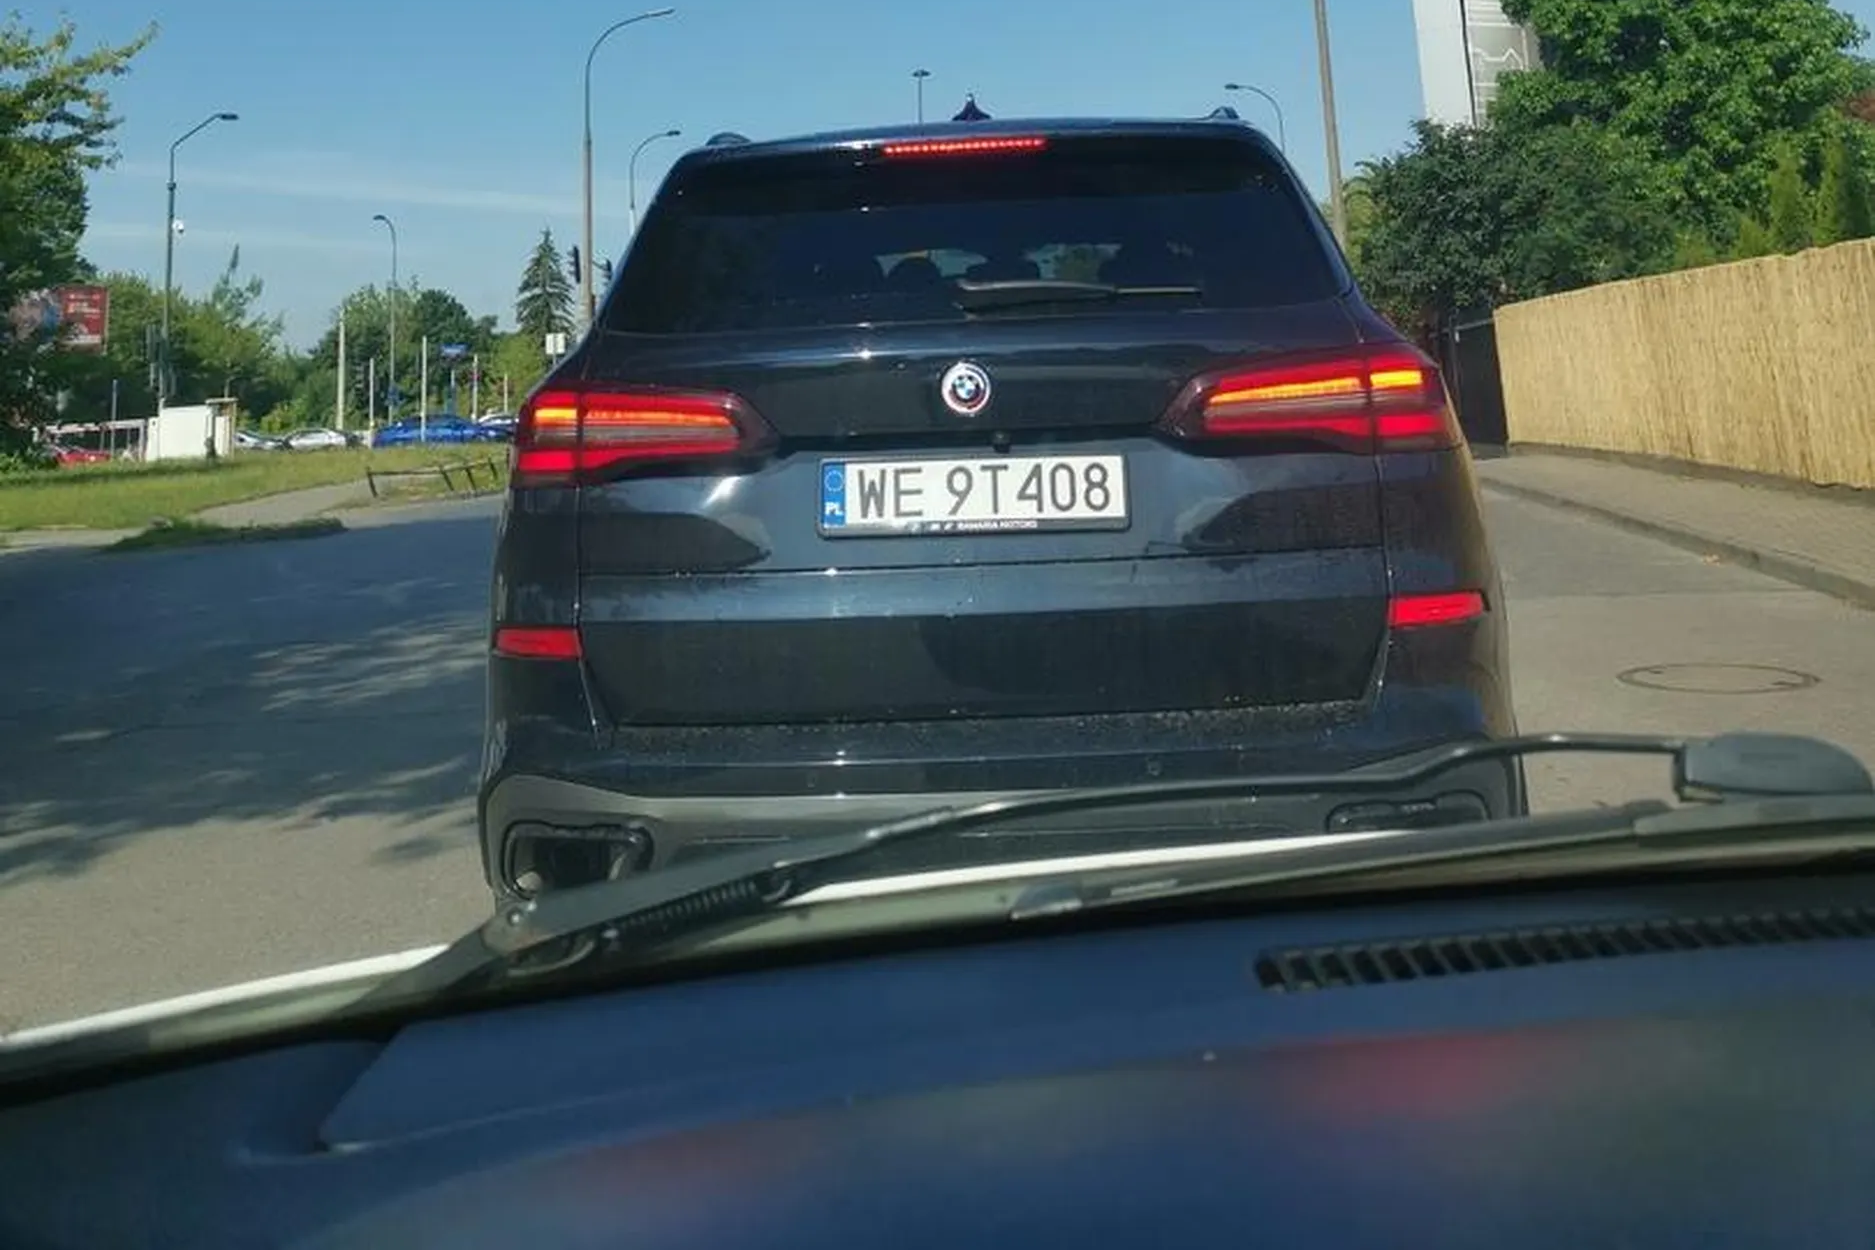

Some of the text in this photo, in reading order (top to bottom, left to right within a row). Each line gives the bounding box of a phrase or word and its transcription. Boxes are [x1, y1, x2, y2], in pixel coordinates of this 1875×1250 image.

[824, 501, 843, 515] PL
[858, 462, 1111, 519] WE 9T408
